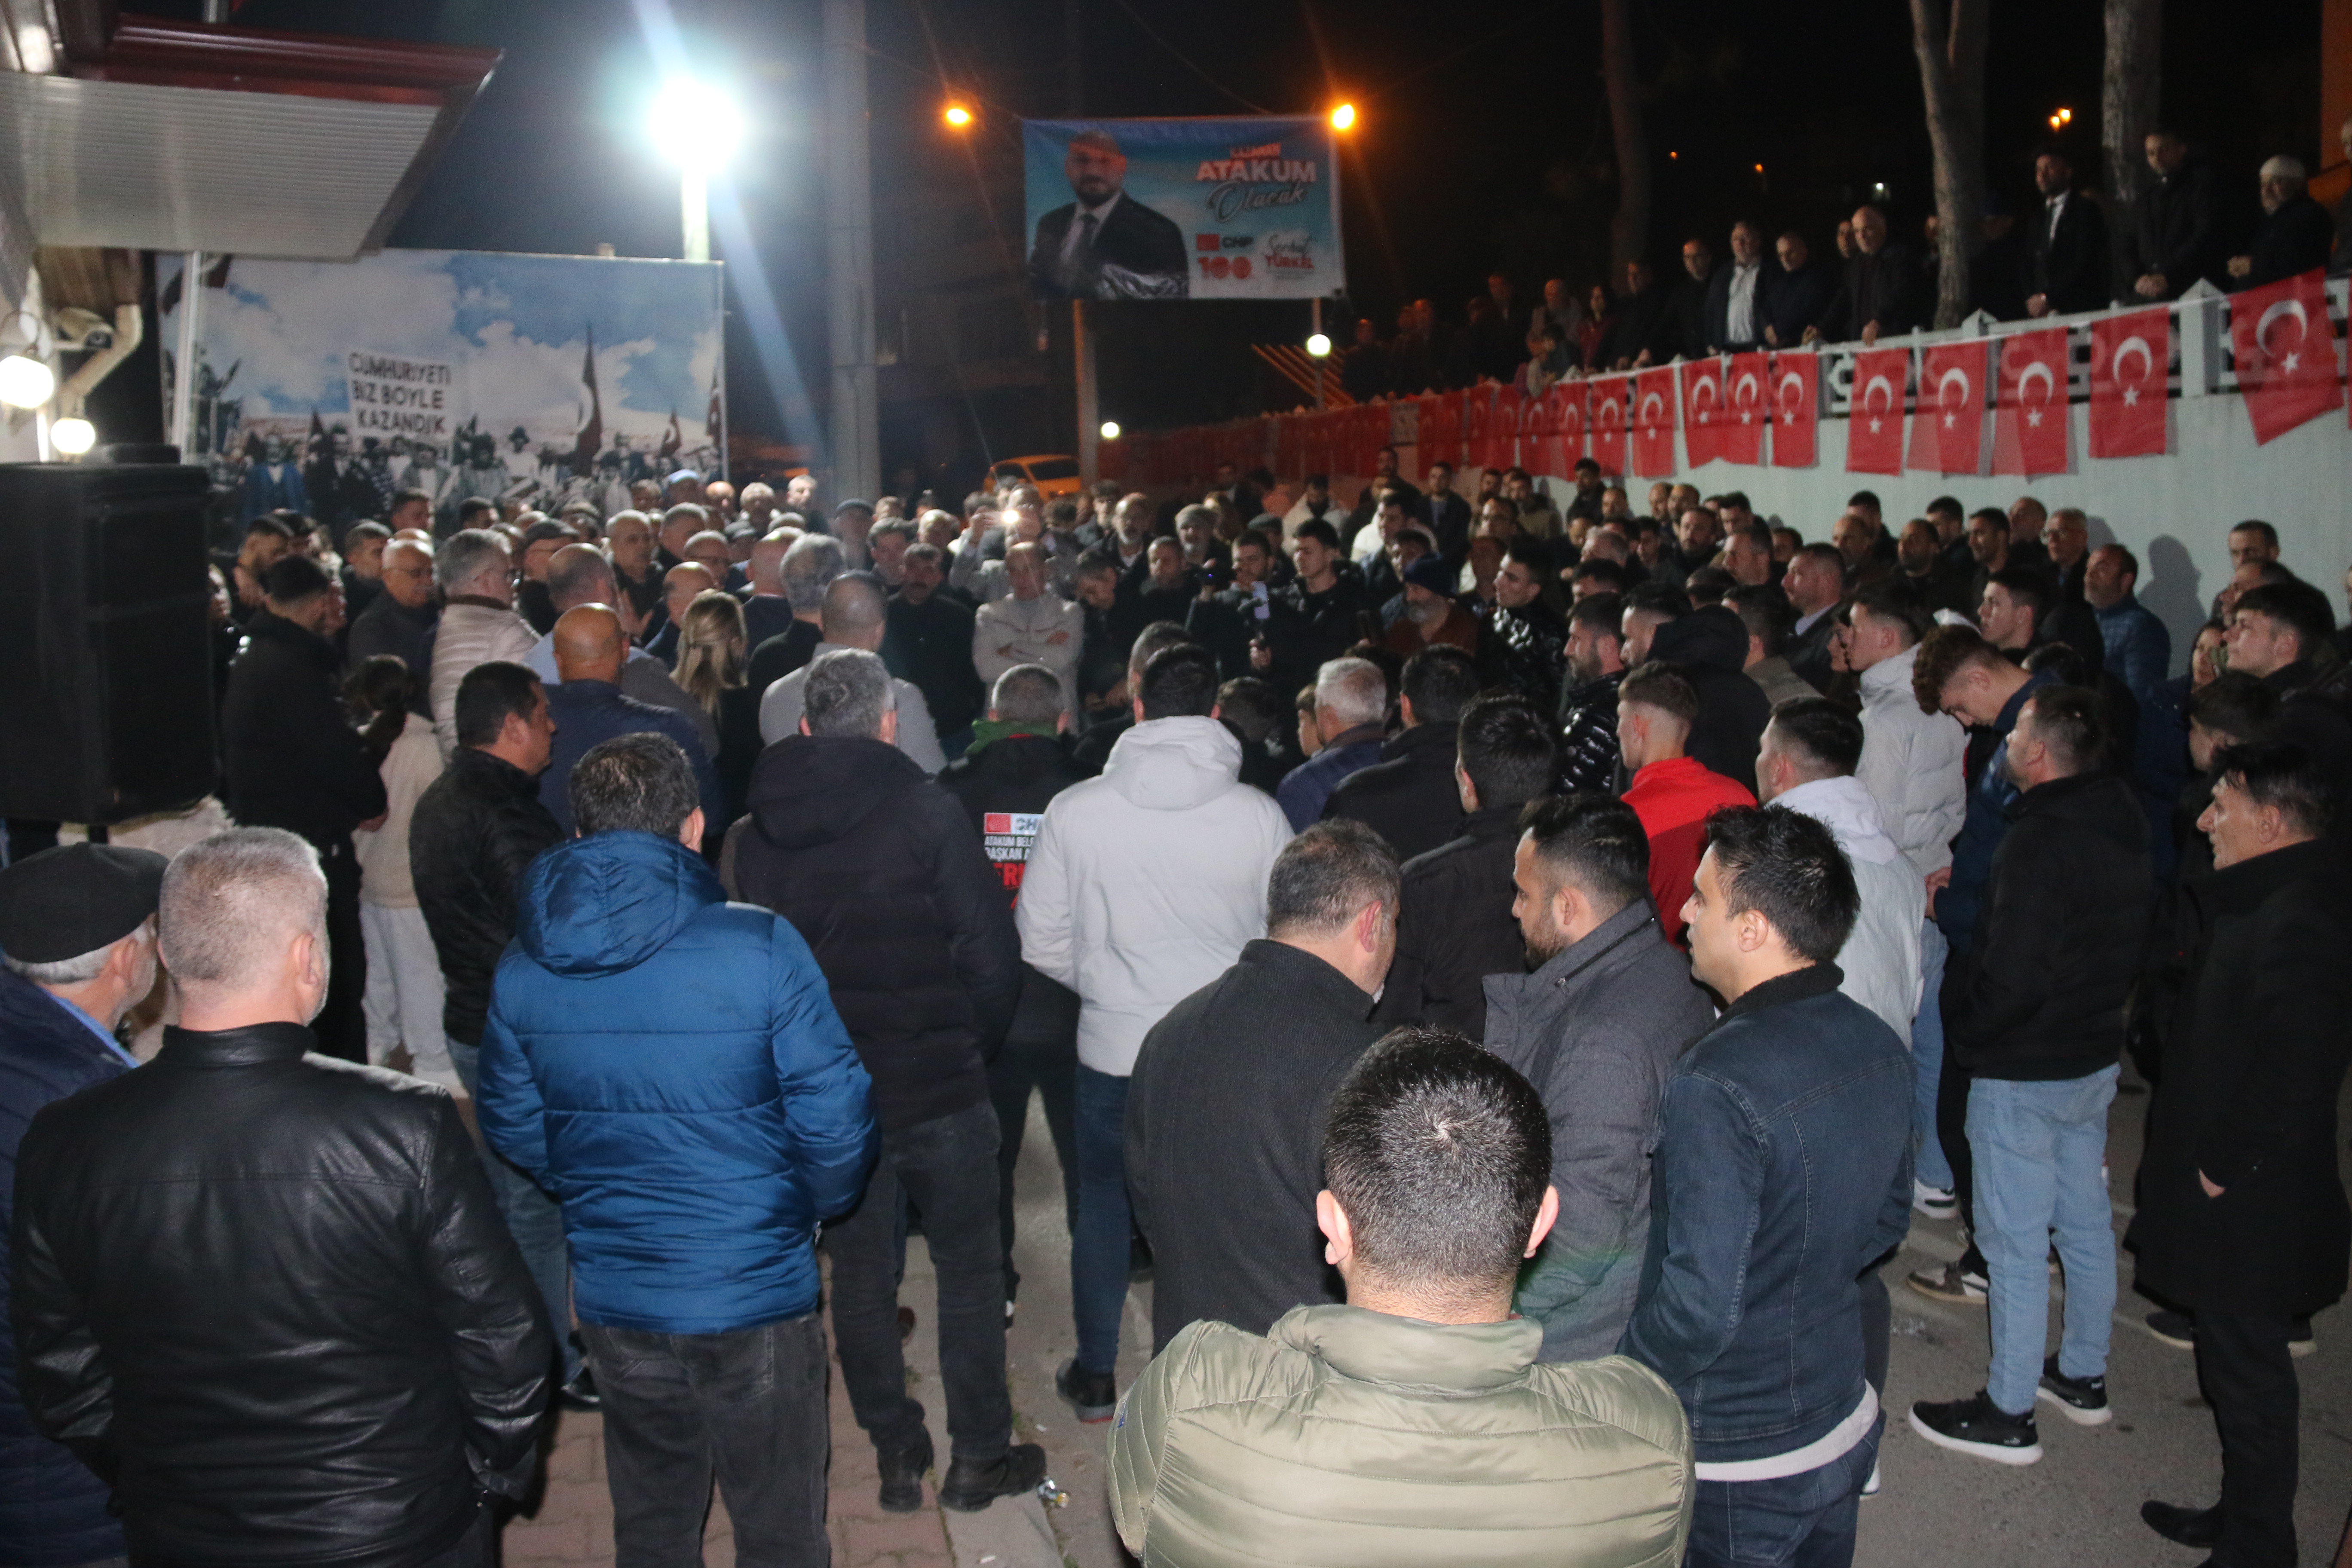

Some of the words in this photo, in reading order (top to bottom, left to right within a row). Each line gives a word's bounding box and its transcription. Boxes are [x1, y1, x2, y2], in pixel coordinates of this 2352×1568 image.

[1196, 158, 1317, 182] ATAKUM
[1207, 180, 1308, 223] Olacak
[1222, 236, 1254, 248] CHP
[1015, 818, 1037, 830] CH
